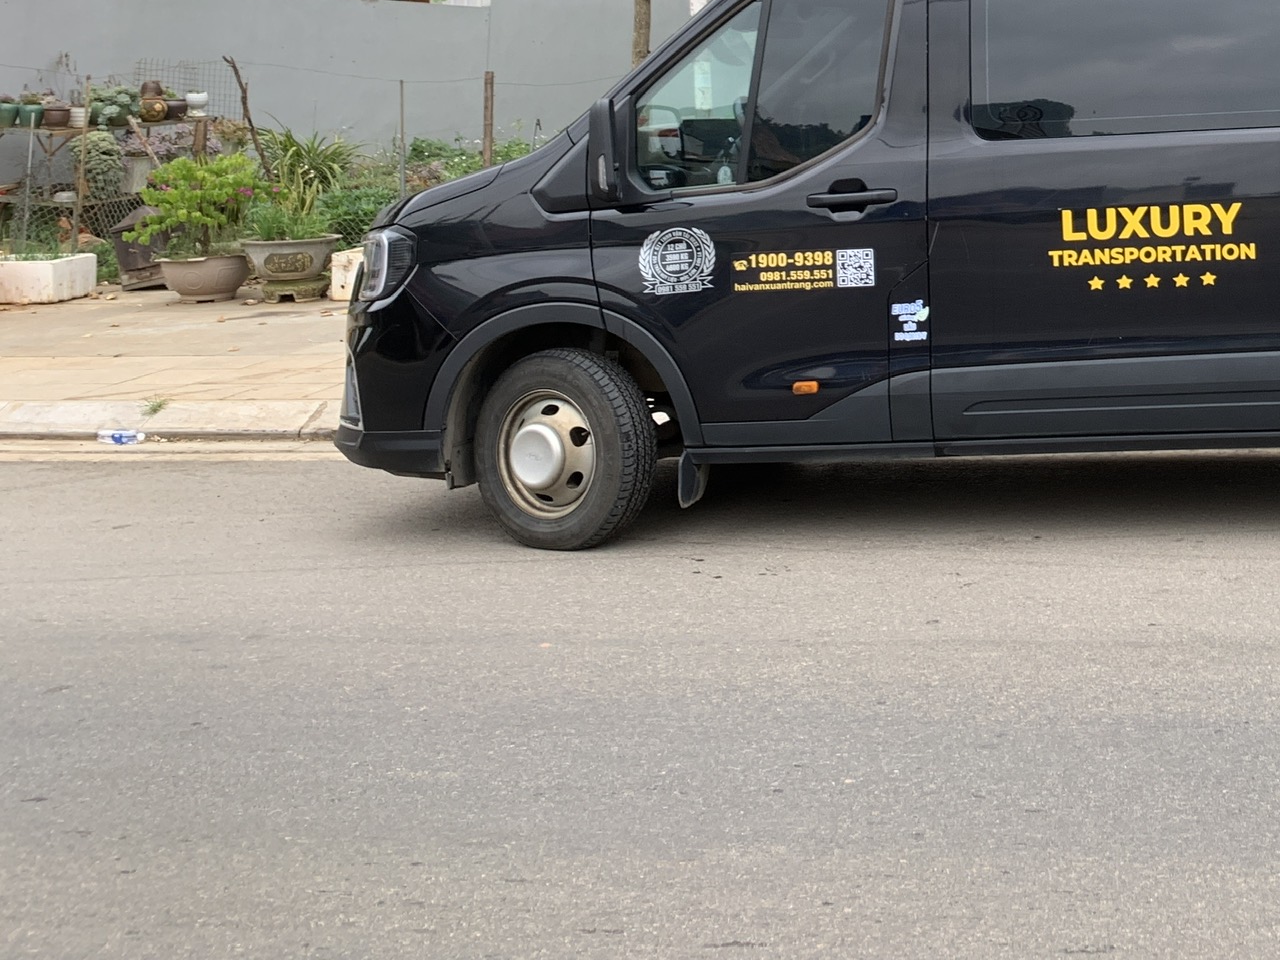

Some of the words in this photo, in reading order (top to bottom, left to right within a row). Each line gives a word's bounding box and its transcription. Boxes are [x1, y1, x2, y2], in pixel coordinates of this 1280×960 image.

[1061, 202, 1242, 241] LUXURY
[748, 251, 833, 268] 1900-9398
[1048, 243, 1256, 267] TRANSPORTATION
[760, 269, 833, 281] 0981.559.551
[734, 279, 834, 291] haivanxuantrang.com
